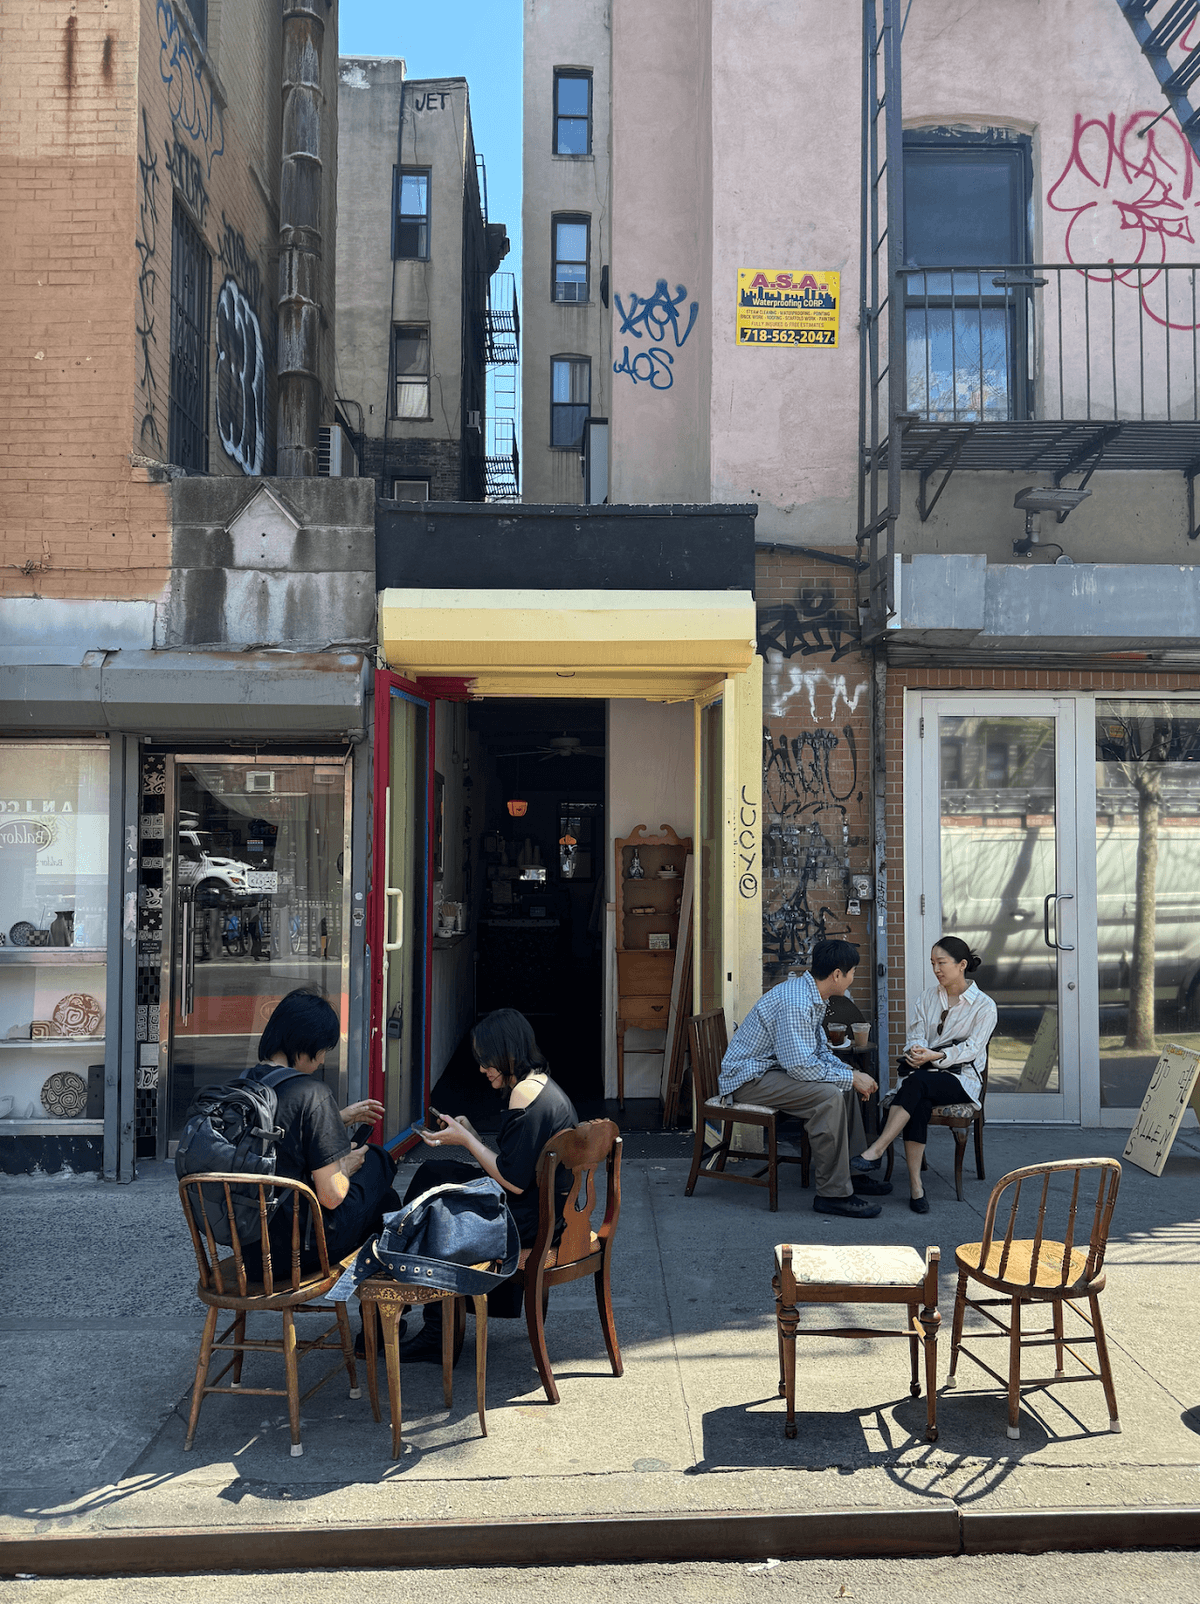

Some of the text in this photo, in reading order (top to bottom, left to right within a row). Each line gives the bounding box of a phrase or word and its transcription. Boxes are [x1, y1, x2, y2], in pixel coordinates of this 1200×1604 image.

[749, 272, 829, 291] A.S.A.
[753, 299, 825, 309] Waterproofing CORP.
[743, 329, 832, 343] 718-562-2047
[1132, 1113, 1171, 1145] ALLEN
